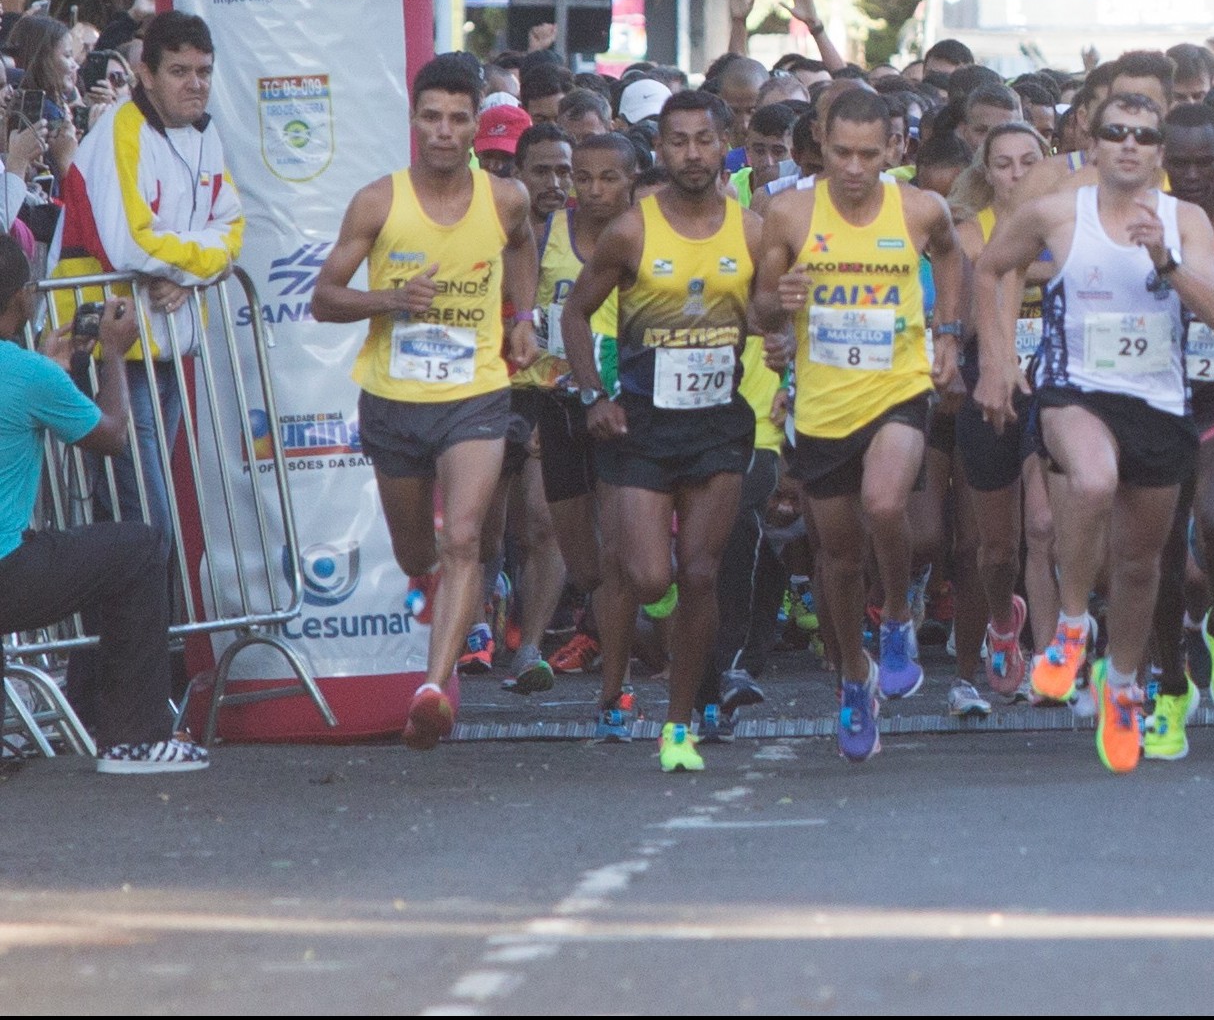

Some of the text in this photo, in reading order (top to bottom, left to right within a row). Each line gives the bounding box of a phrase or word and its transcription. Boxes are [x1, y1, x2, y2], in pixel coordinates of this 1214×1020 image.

[813, 284, 900, 306] CAIXA
[827, 330, 884, 341] MARCELO
[847, 346, 861, 366] 8
[1118, 337, 1149, 357] 29
[425, 360, 449, 380] 15
[1196, 358, 1212, 378] 2
[674, 370, 726, 392] 1270
[243, 459, 324, 475] POFSÕES
[328, 459, 346, 469] DA
